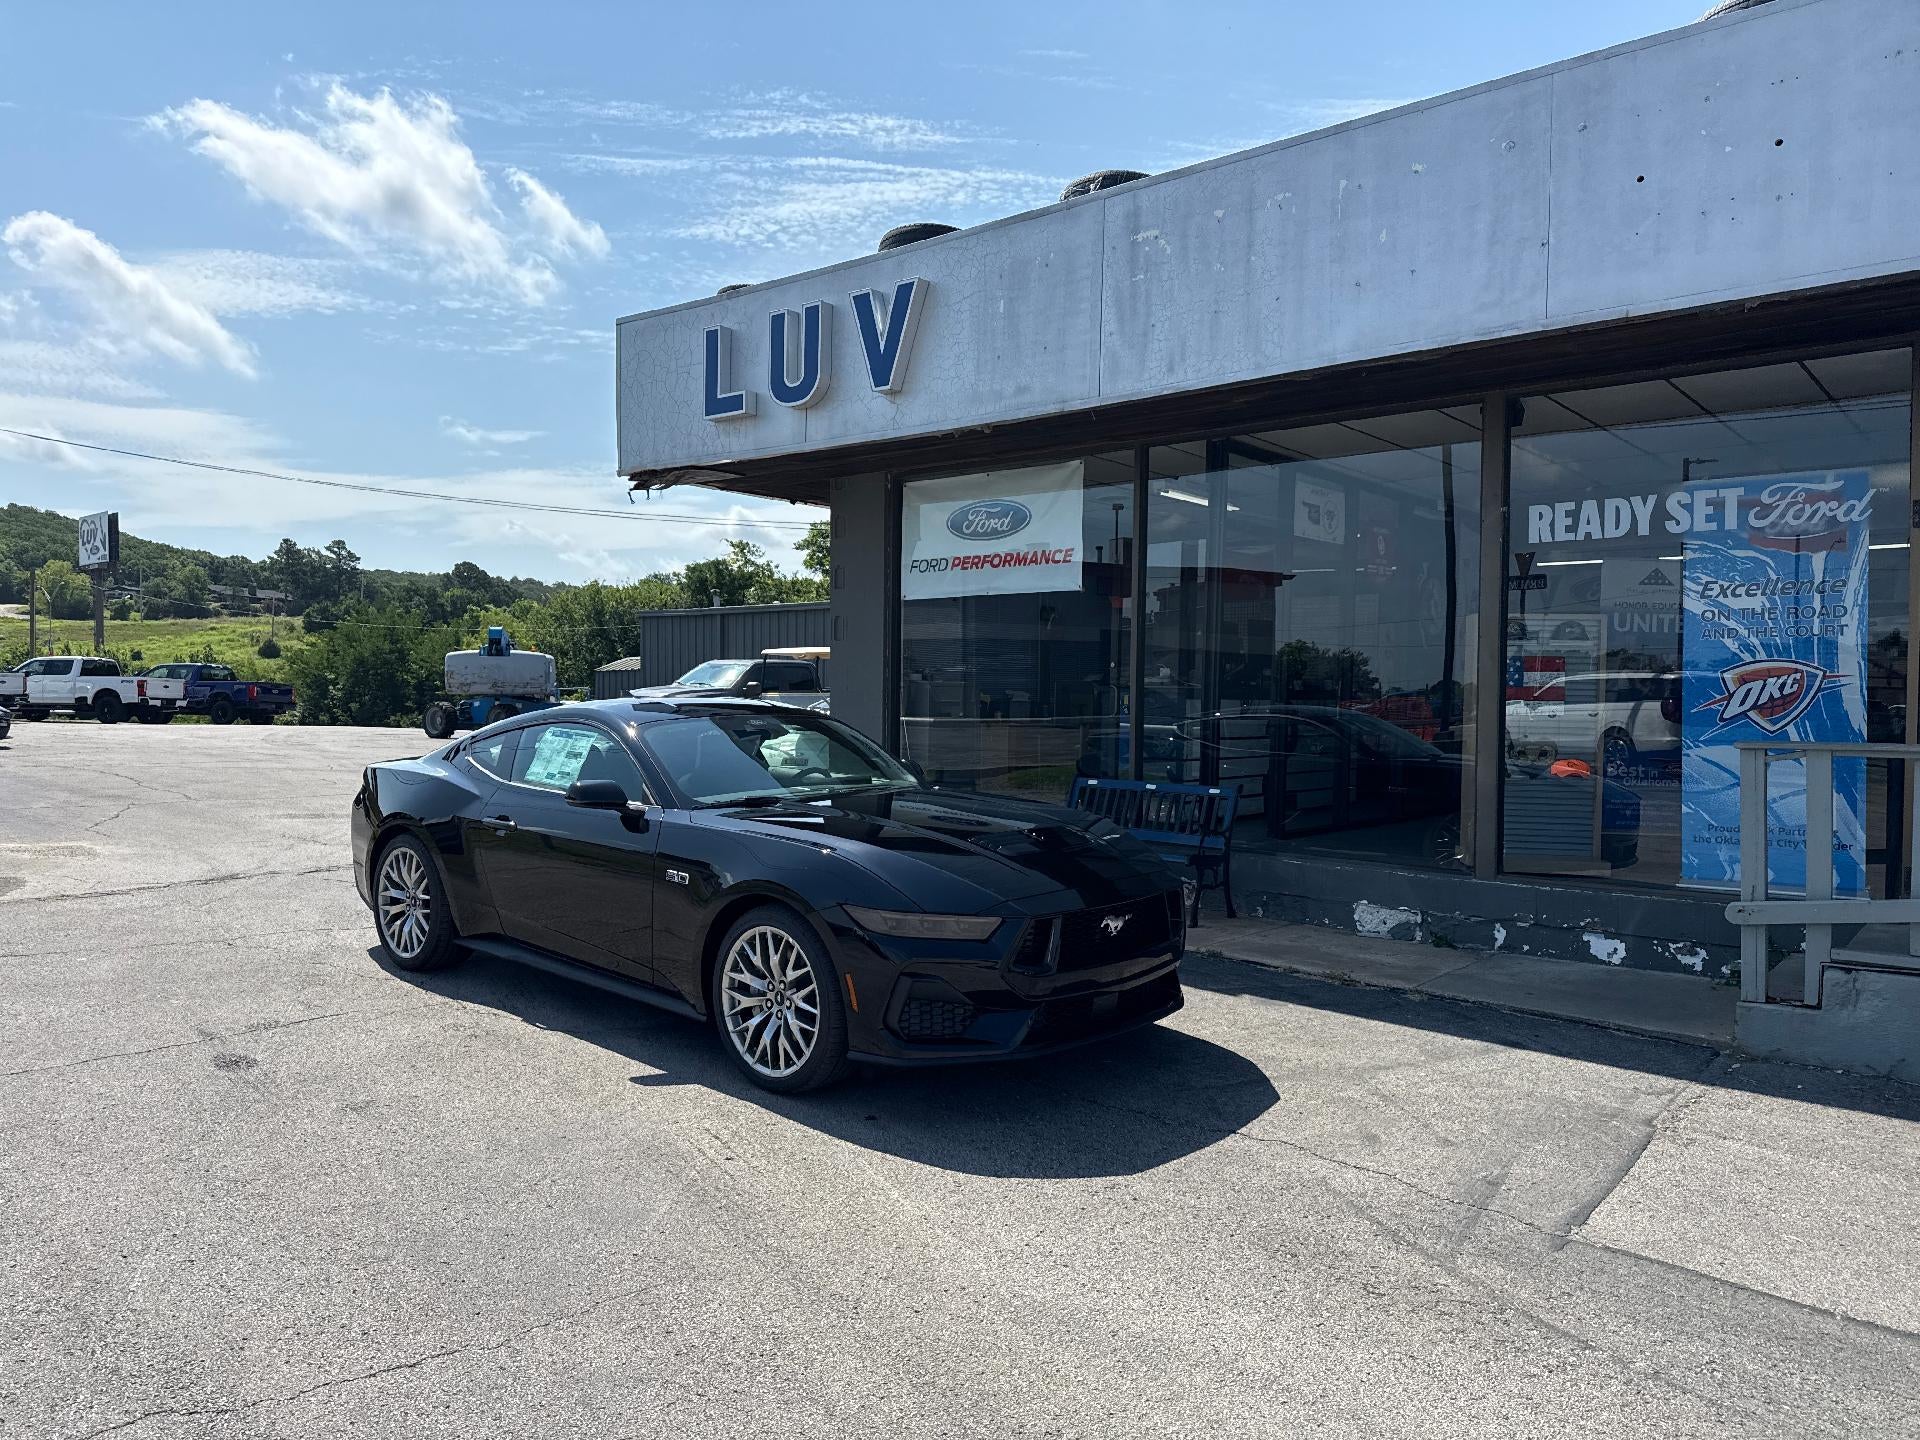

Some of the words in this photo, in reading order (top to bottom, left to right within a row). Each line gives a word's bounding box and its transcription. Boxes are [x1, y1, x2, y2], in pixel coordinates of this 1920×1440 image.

[703, 276, 929, 420] LUV
[962, 506, 1014, 534] Ford
[1528, 494, 1657, 544] READY
[1665, 487, 1744, 535] SET
[1748, 479, 1876, 528] Ford
[910, 557, 948, 574] FORD
[950, 547, 1075, 571] PERFORMANCE
[1700, 576, 1847, 600] Excellence
[1701, 608, 1731, 623] ON
[1739, 606, 1779, 622] THE
[1786, 604, 1848, 621] ROAD
[1700, 627, 1740, 640] AND
[1746, 625, 1779, 638] THE
[1784, 624, 1849, 638] COURT
[1722, 672, 1802, 719] OKC
[1606, 763, 1645, 777] Best
[1707, 823, 1741, 833] Proud
[1694, 835, 1711, 844] the
[1777, 838, 1799, 850] City
